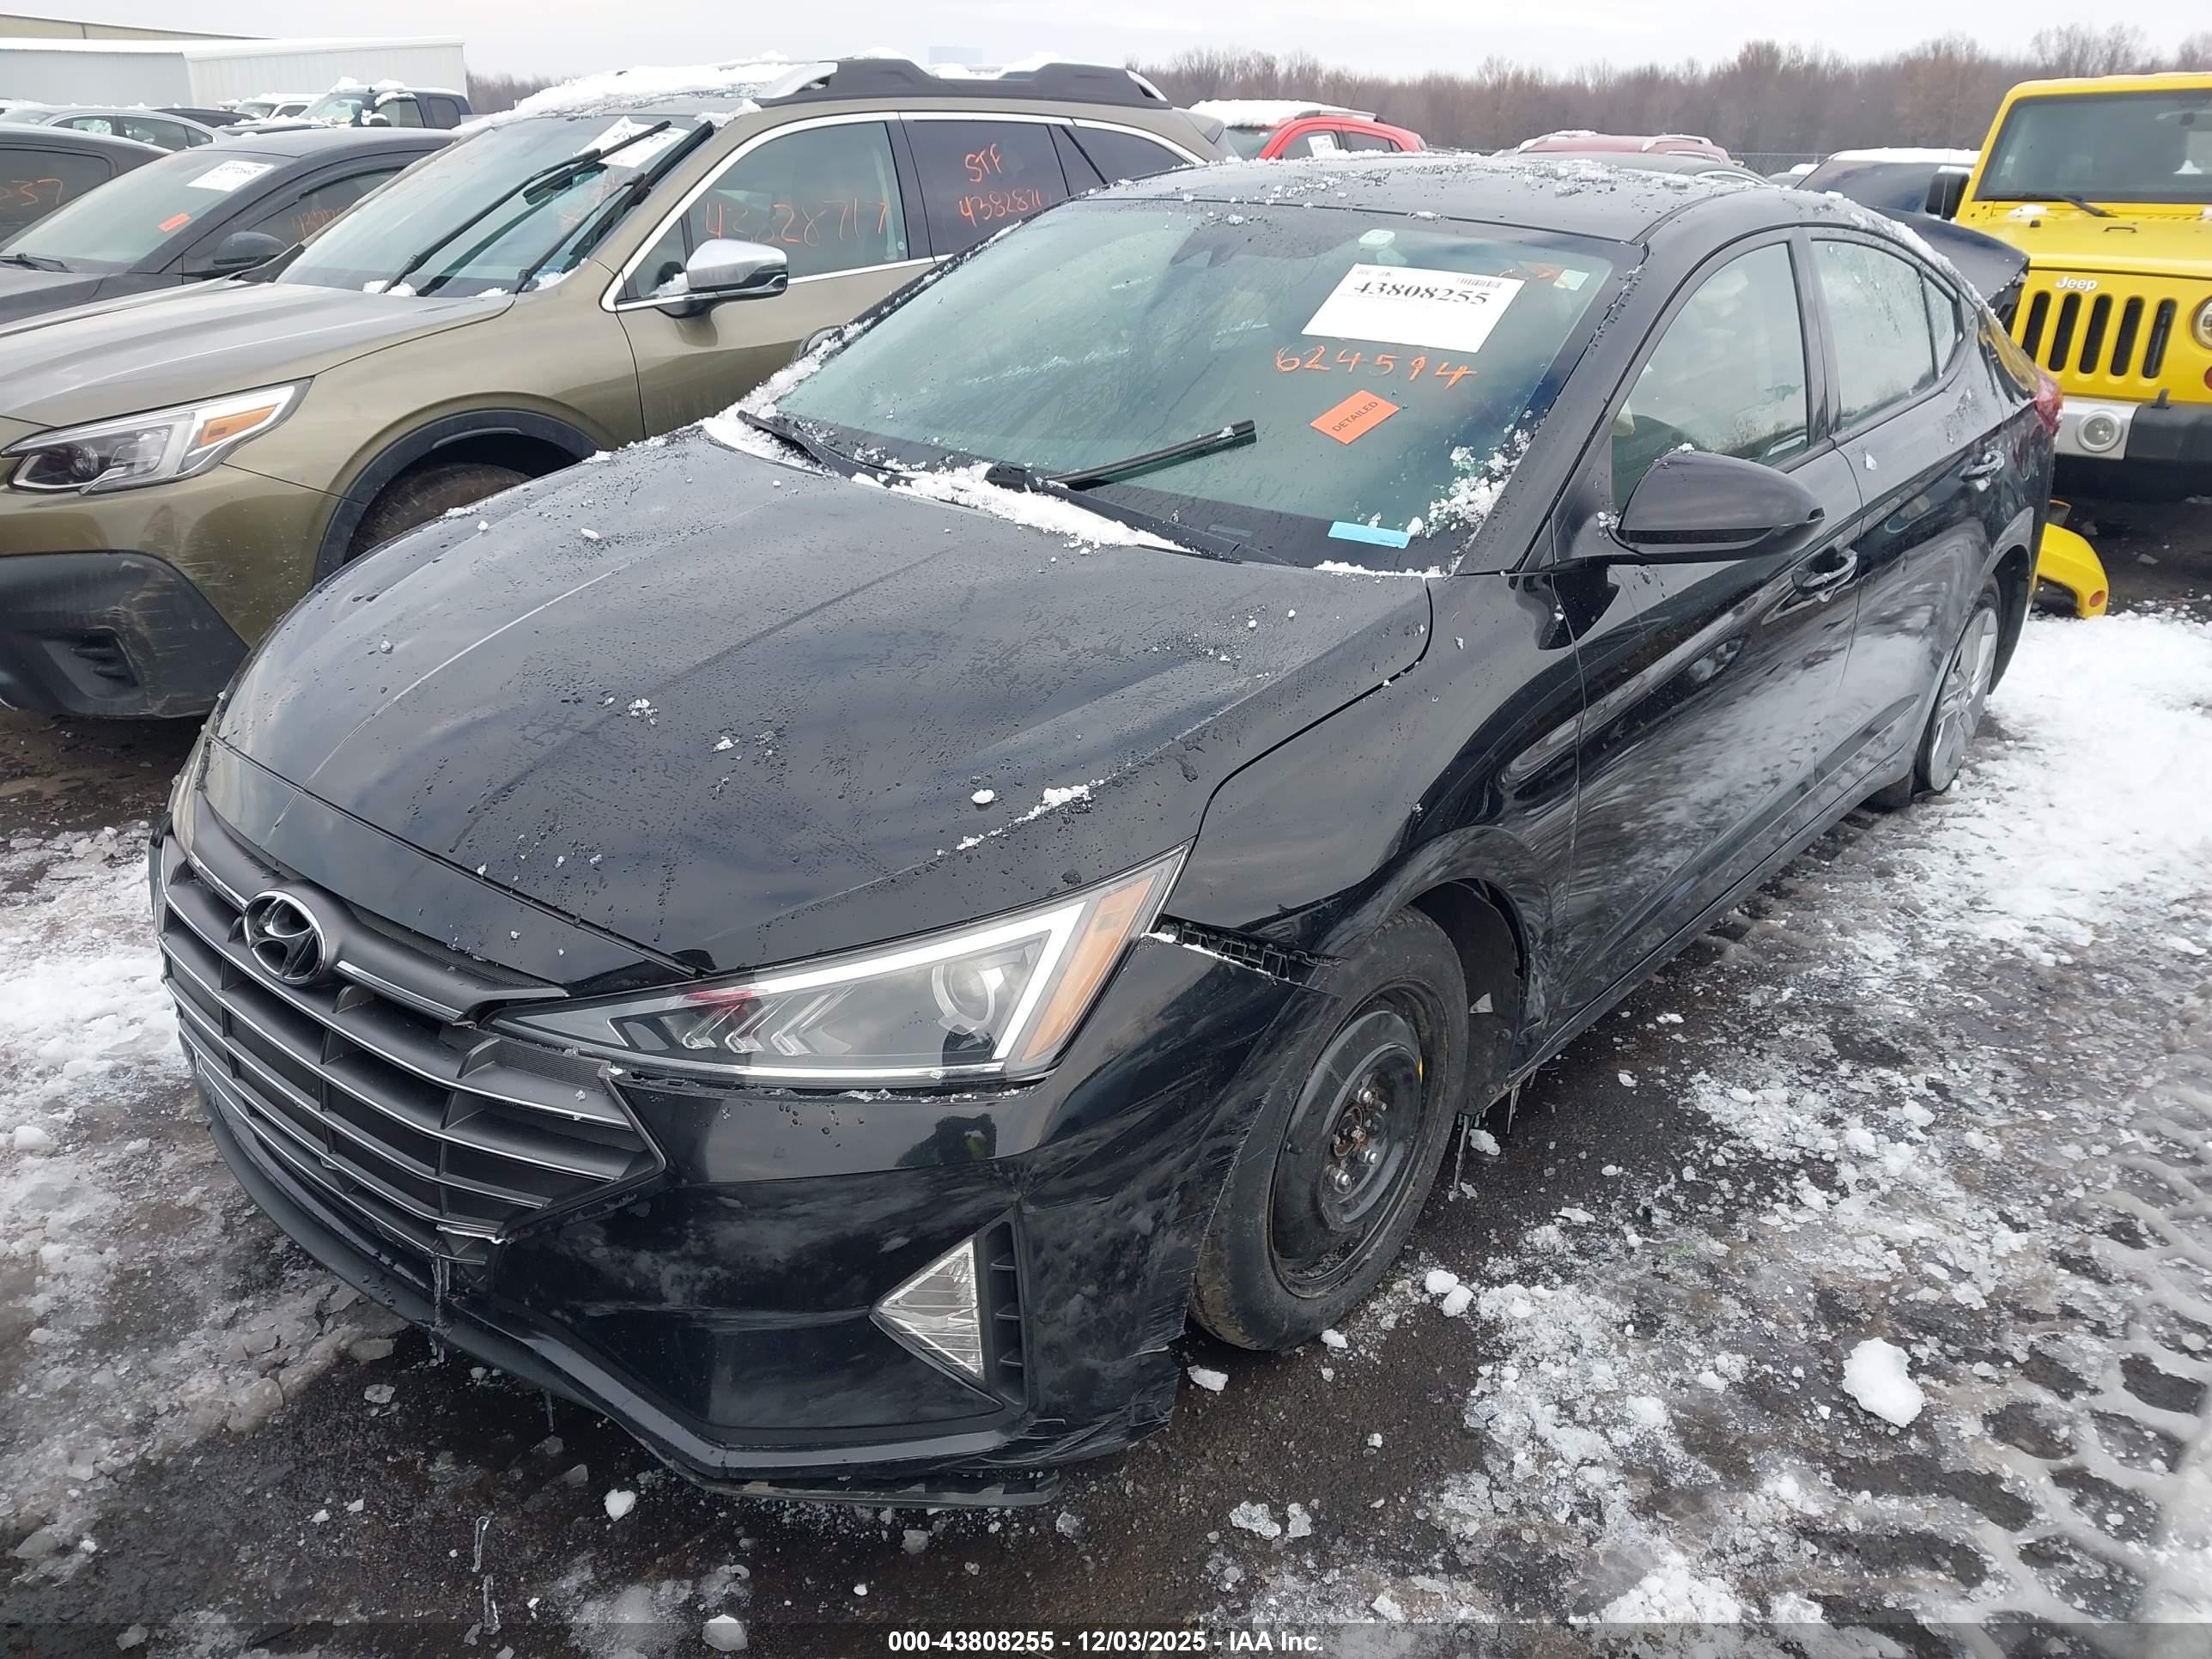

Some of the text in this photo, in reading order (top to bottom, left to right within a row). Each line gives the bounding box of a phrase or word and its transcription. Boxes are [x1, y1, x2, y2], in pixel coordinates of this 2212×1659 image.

[1354, 280, 1492, 307] 43808255
[2055, 275, 2099, 293] Jeep
[1332, 400, 1379, 433] DETAILED
